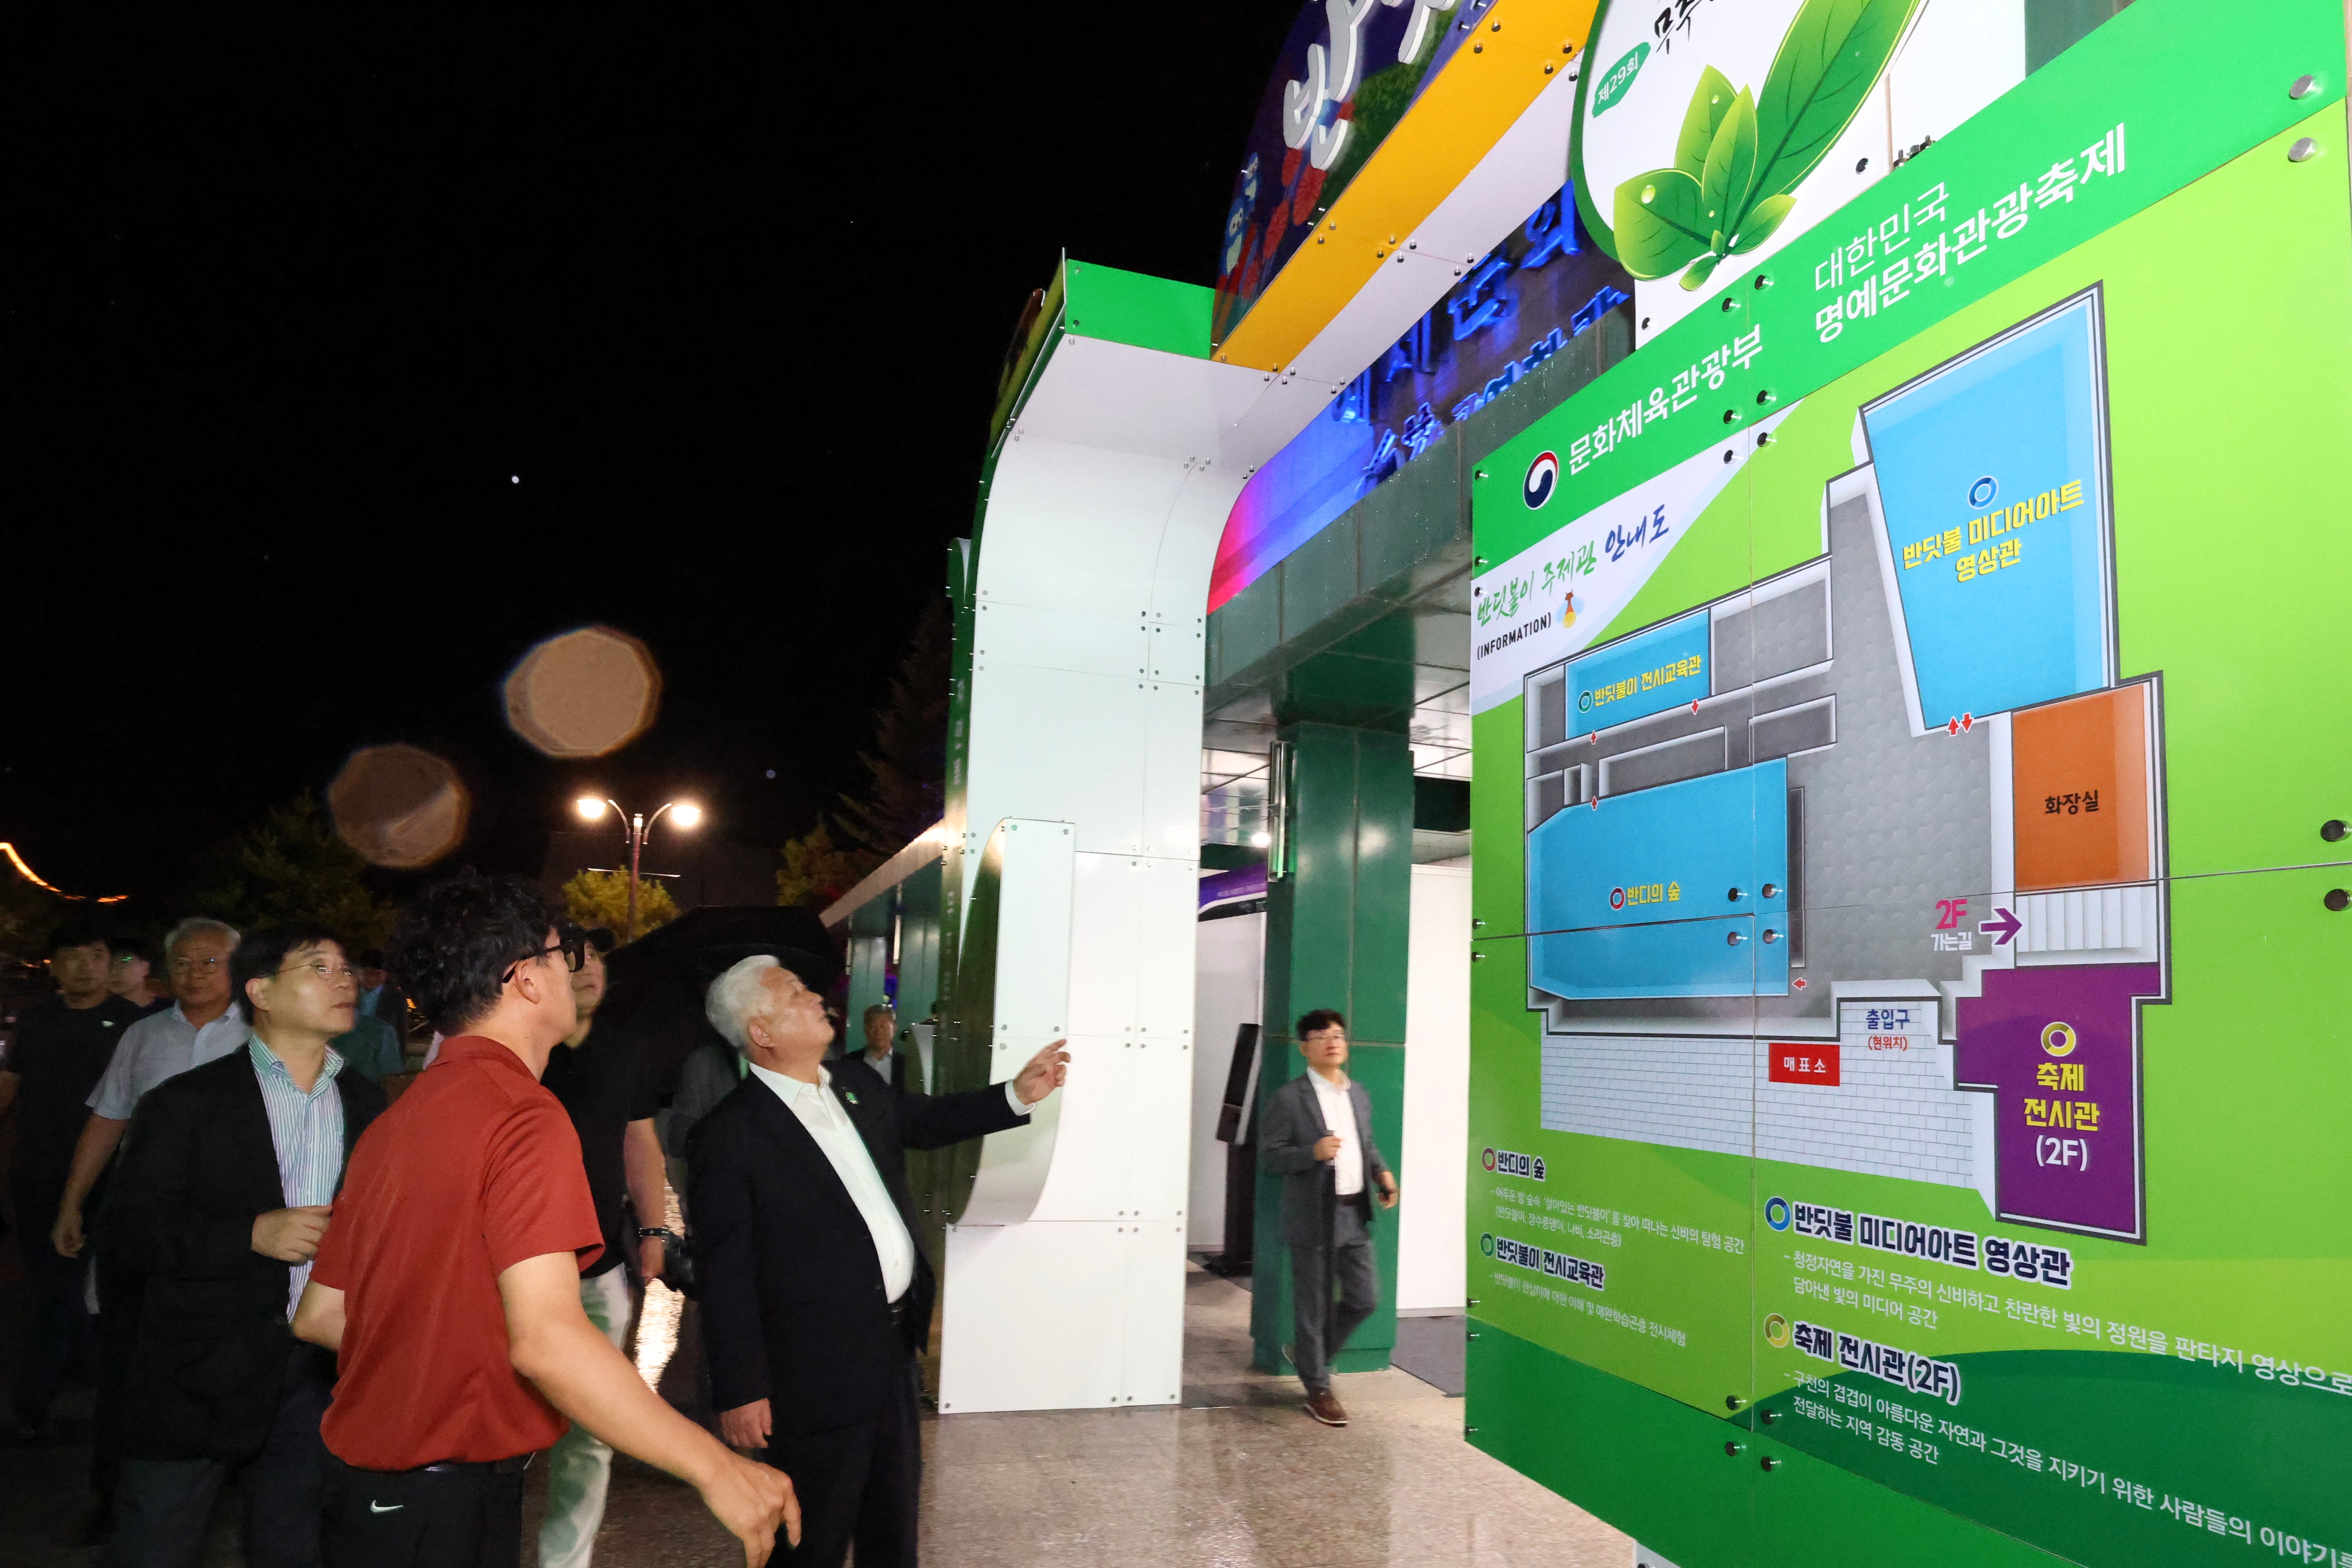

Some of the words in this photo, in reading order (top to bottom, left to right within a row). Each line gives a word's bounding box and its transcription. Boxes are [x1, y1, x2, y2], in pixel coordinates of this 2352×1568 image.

[1597, 51, 1639, 104] 제29회
[1815, 122, 2125, 343] 명예문화관광축제
[1815, 181, 1949, 291] 대한민국
[1569, 324, 1763, 475] 문화체육관광부
[1903, 526, 1962, 570] 반딧불
[1968, 479, 2084, 545] 미디어아트
[1477, 571, 1535, 628] 반딧불이
[1542, 540, 1597, 597] 주제관
[1605, 504, 1669, 563] 안내도
[1955, 538, 2022, 582] 영상관
[1477, 612, 1551, 660] (INFORMATION)
[1594, 676, 1637, 707] 반딧불이
[1641, 654, 1702, 692] 전시교육관
[2045, 789, 2099, 814] 화장실
[1627, 883, 1663, 906] 반디의
[1667, 881, 1680, 901] 숲
[1935, 899, 1968, 929] 2F
[1930, 931, 1973, 951] 가는길
[1866, 1009, 1910, 1030] 출입구
[1868, 1035, 1908, 1051] (현위치)
[2036, 1062, 2084, 1092] 축제
[2024, 1098, 2100, 1132] 전시관
[1497, 1151, 1530, 1176] 반디의
[1533, 1157, 1545, 1180] 숲
[2036, 1135, 2087, 1171] (2F)
[1623, 1214, 1639, 1231] 찾아
[1642, 1218, 1668, 1237] 떠나는
[1671, 1224, 1699, 1244] 신비의
[1701, 1230, 1721, 1249] 탐험
[1724, 1236, 1745, 1255] 공간
[1794, 1204, 1852, 1242] 반딧불
[1860, 1216, 1977, 1267] 미디어아트
[1985, 1239, 2070, 1286] 영상관
[1496, 1238, 1539, 1269] 반딧불이
[1543, 1252, 1604, 1289] 전시교육관
[1552, 1290, 1567, 1307] 대한
[1569, 1296, 1584, 1313] 이해
[1587, 1301, 1594, 1316] 및
[1793, 1250, 1855, 1280] 청정자연을
[1859, 1266, 1885, 1288] 가진
[1889, 1273, 1932, 1299] 무주의
[1936, 1283, 2000, 1314] 신비하고
[2005, 1298, 2058, 1329] 찬란한
[2064, 1311, 2100, 1339] 빛의
[2107, 1321, 2168, 1355] 정원을
[2175, 1336, 2243, 1373] 판타지
[2251, 1354, 2352, 1396] 영상으로
[1794, 1277, 1829, 1301] 담아낸
[1834, 1286, 1858, 1309] 빛의
[1863, 1294, 1903, 1321] 미디어
[1908, 1305, 1938, 1329] 공간
[1794, 1323, 1832, 1360] 축제
[1793, 1395, 1842, 1429] 전달하는
[1845, 1415, 1872, 1441] 지역
[1876, 1426, 1904, 1452] 감동
[1908, 1438, 1939, 1465] 공간
[1793, 1370, 1830, 1398] 구천의
[1834, 1384, 1872, 1413] 겹겹이
[1876, 1398, 1934, 1434] 아름다운
[1938, 1419, 1987, 1452] 자연과
[1990, 1438, 2043, 1472] 그것을
[2048, 1456, 2105, 1495] 지키기
[2112, 1478, 2154, 1510] 위한
[2159, 1494, 2252, 1545] 사람들의
